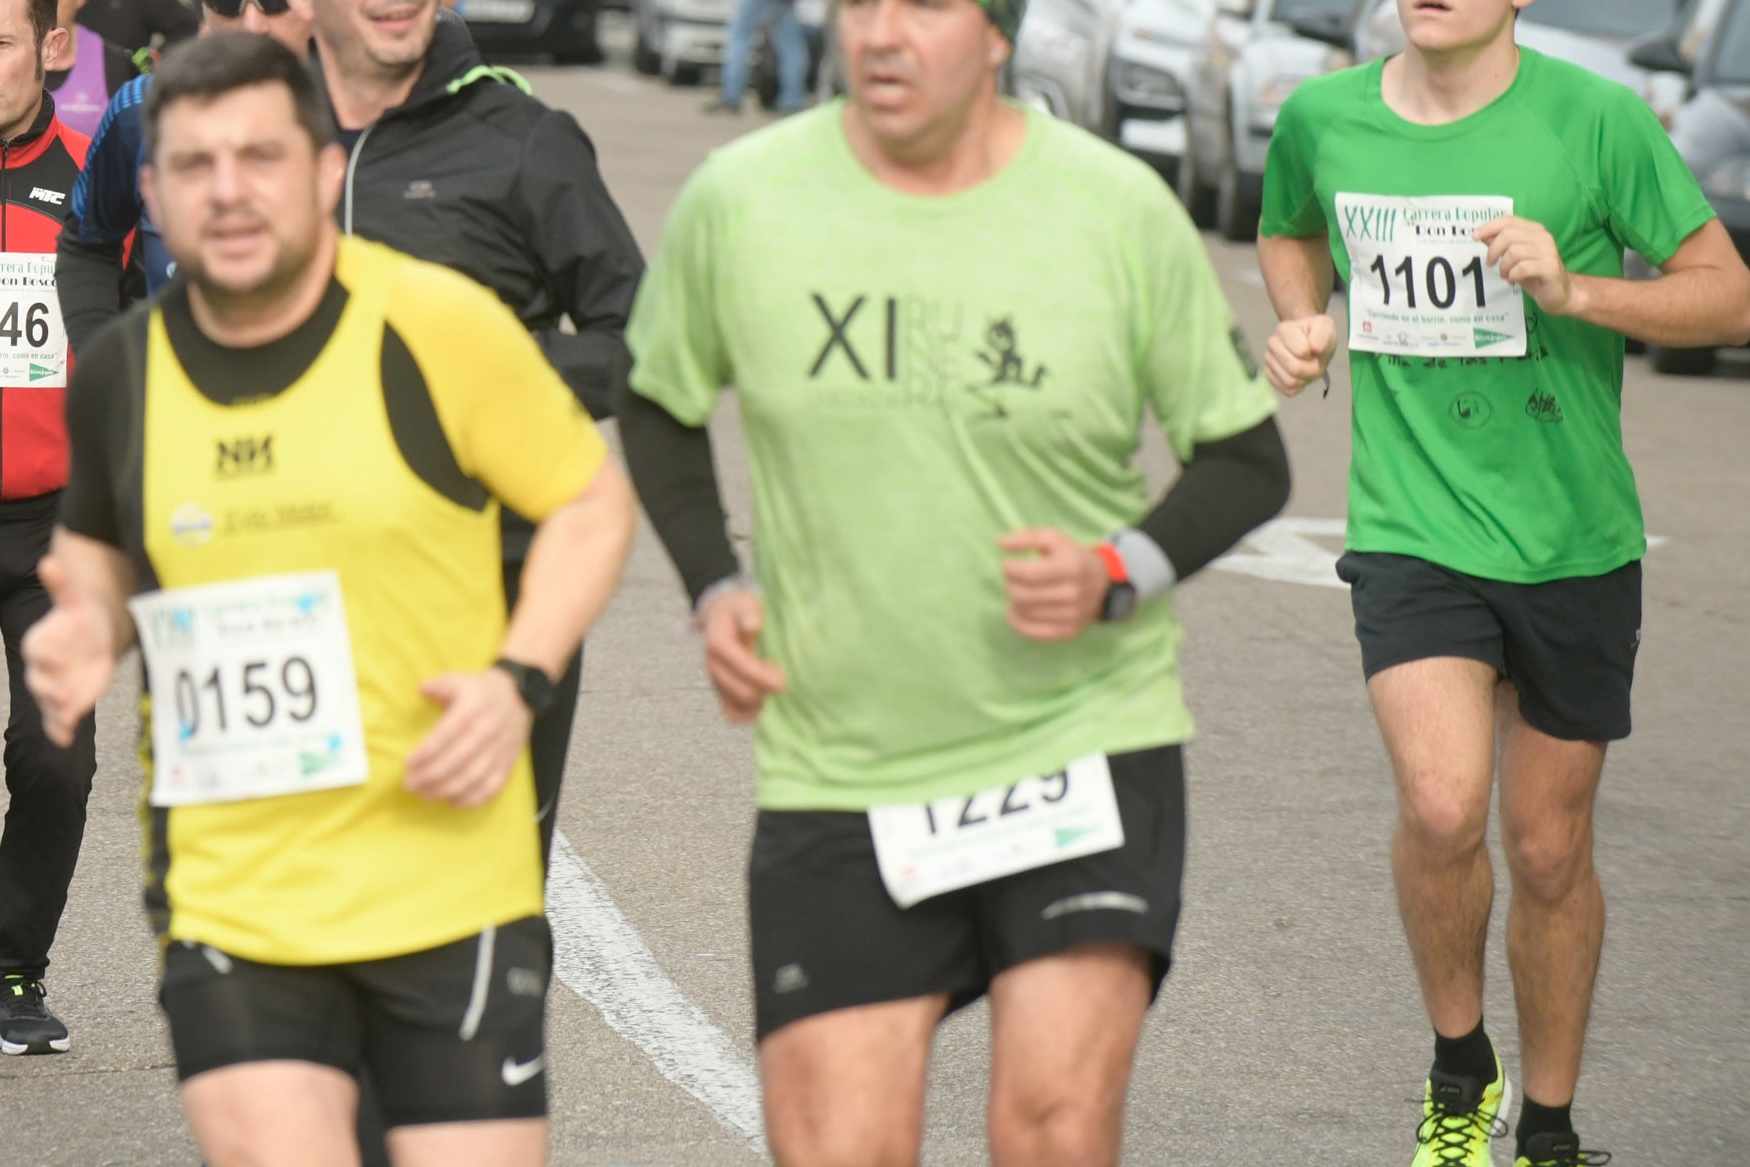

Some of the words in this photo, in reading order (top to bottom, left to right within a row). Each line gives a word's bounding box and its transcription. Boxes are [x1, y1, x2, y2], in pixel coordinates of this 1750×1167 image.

[1344, 205, 1396, 242] XXIII
[1371, 254, 1486, 309] 1101
[174, 656, 318, 742] 0159
